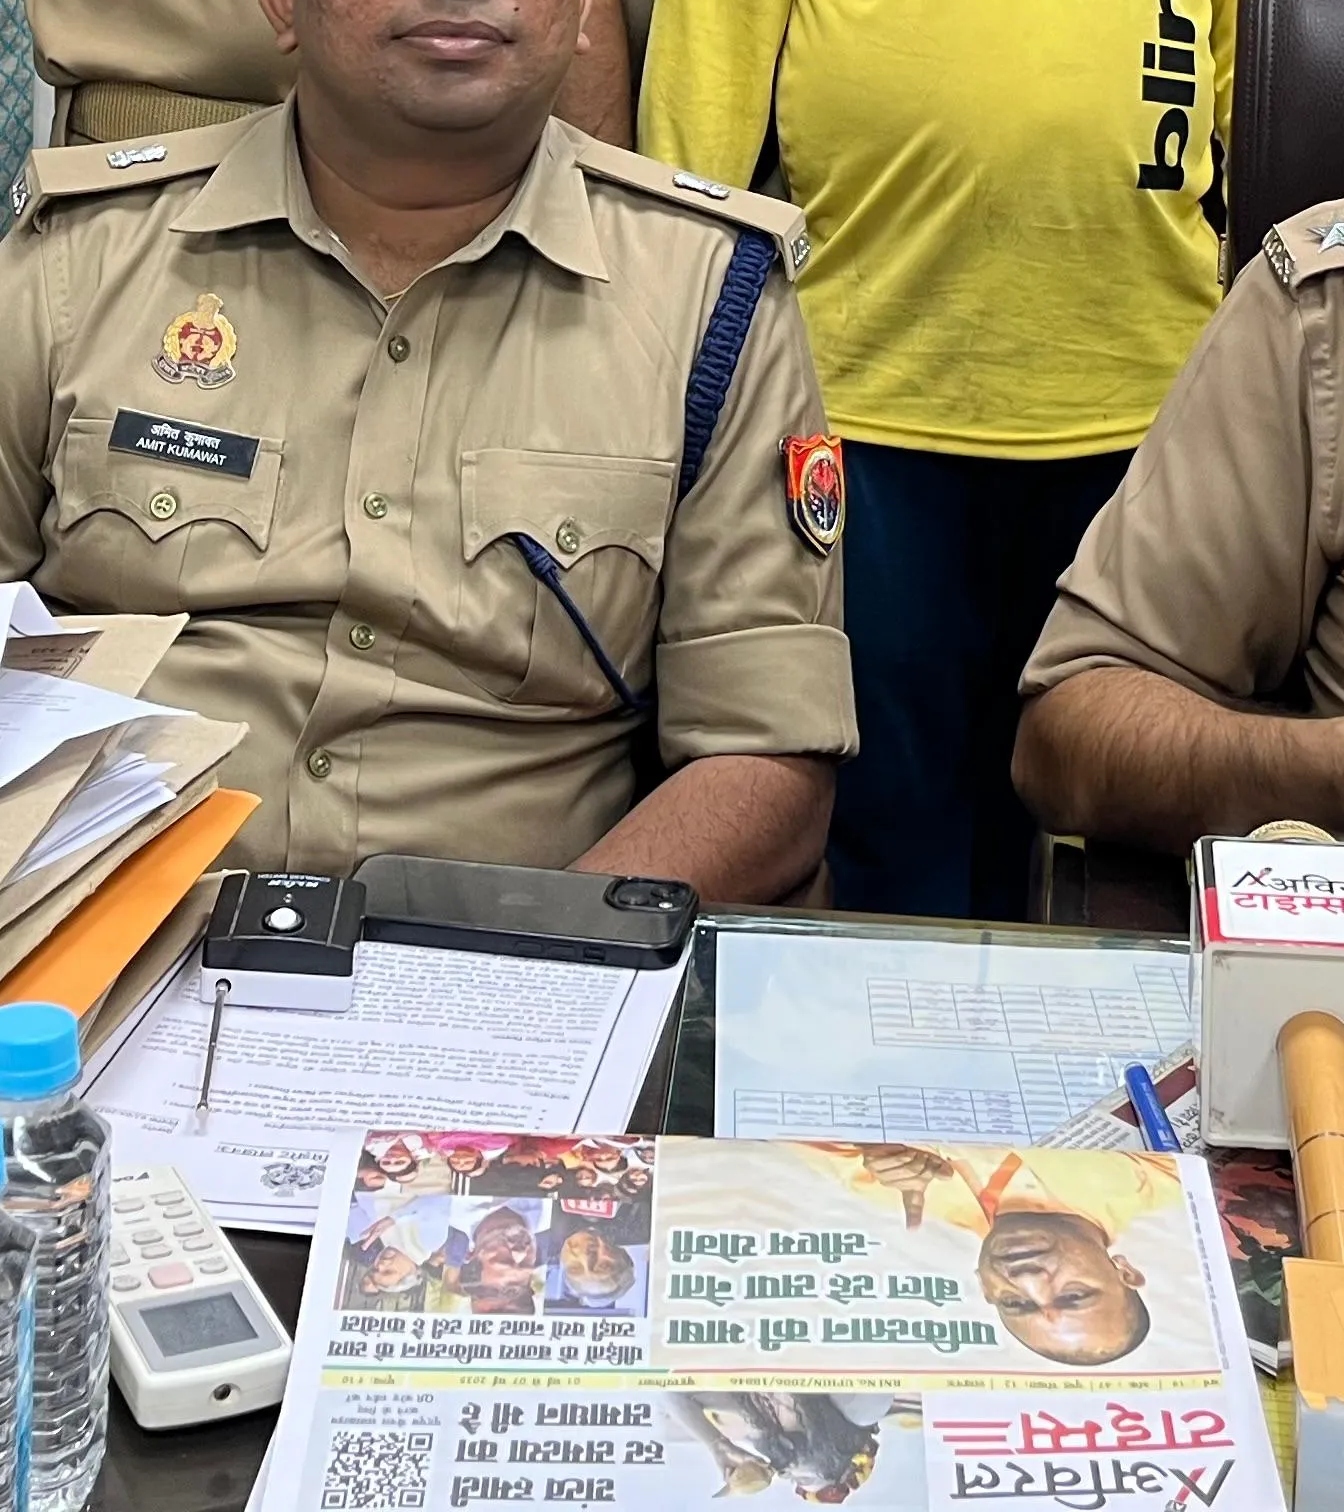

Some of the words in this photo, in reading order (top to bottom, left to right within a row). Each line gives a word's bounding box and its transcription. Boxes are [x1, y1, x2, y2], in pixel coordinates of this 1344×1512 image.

[150, 422, 181, 441] अमित
[135, 437, 167, 454] AMIT
[167, 443, 227, 467] KUMAWAT
[669, 1230, 757, 1264] योगी
[668, 1273, 733, 1309] नेता
[744, 1273, 816, 1301] सपा
[826, 1272, 878, 1307] रहे
[886, 1274, 961, 1306] बोल
[411, 1317, 426, 1341] है
[468, 1318, 494, 1336] आ
[666, 1319, 745, 1346] भाषा
[755, 1320, 810, 1354] की
[822, 1318, 997, 1353] पाकिस्तान
[374, 1341, 395, 1362] के
[400, 1341, 493, 1364] पाकिस्तान
[558, 1343, 580, 1365] के
[459, 1402, 482, 1436] है
[490, 1402, 526, 1435] भी
[535, 1402, 653, 1429] समाधान
[1016, 1401, 1236, 1455] टाइम्स
[454, 1438, 499, 1464] का
[508, 1439, 616, 1465] समस्या
[623, 1440, 665, 1465] हर
[451, 1475, 535, 1510] हमारी
[544, 1475, 617, 1509] शंख
[950, 1458, 1169, 1511] अविरल
